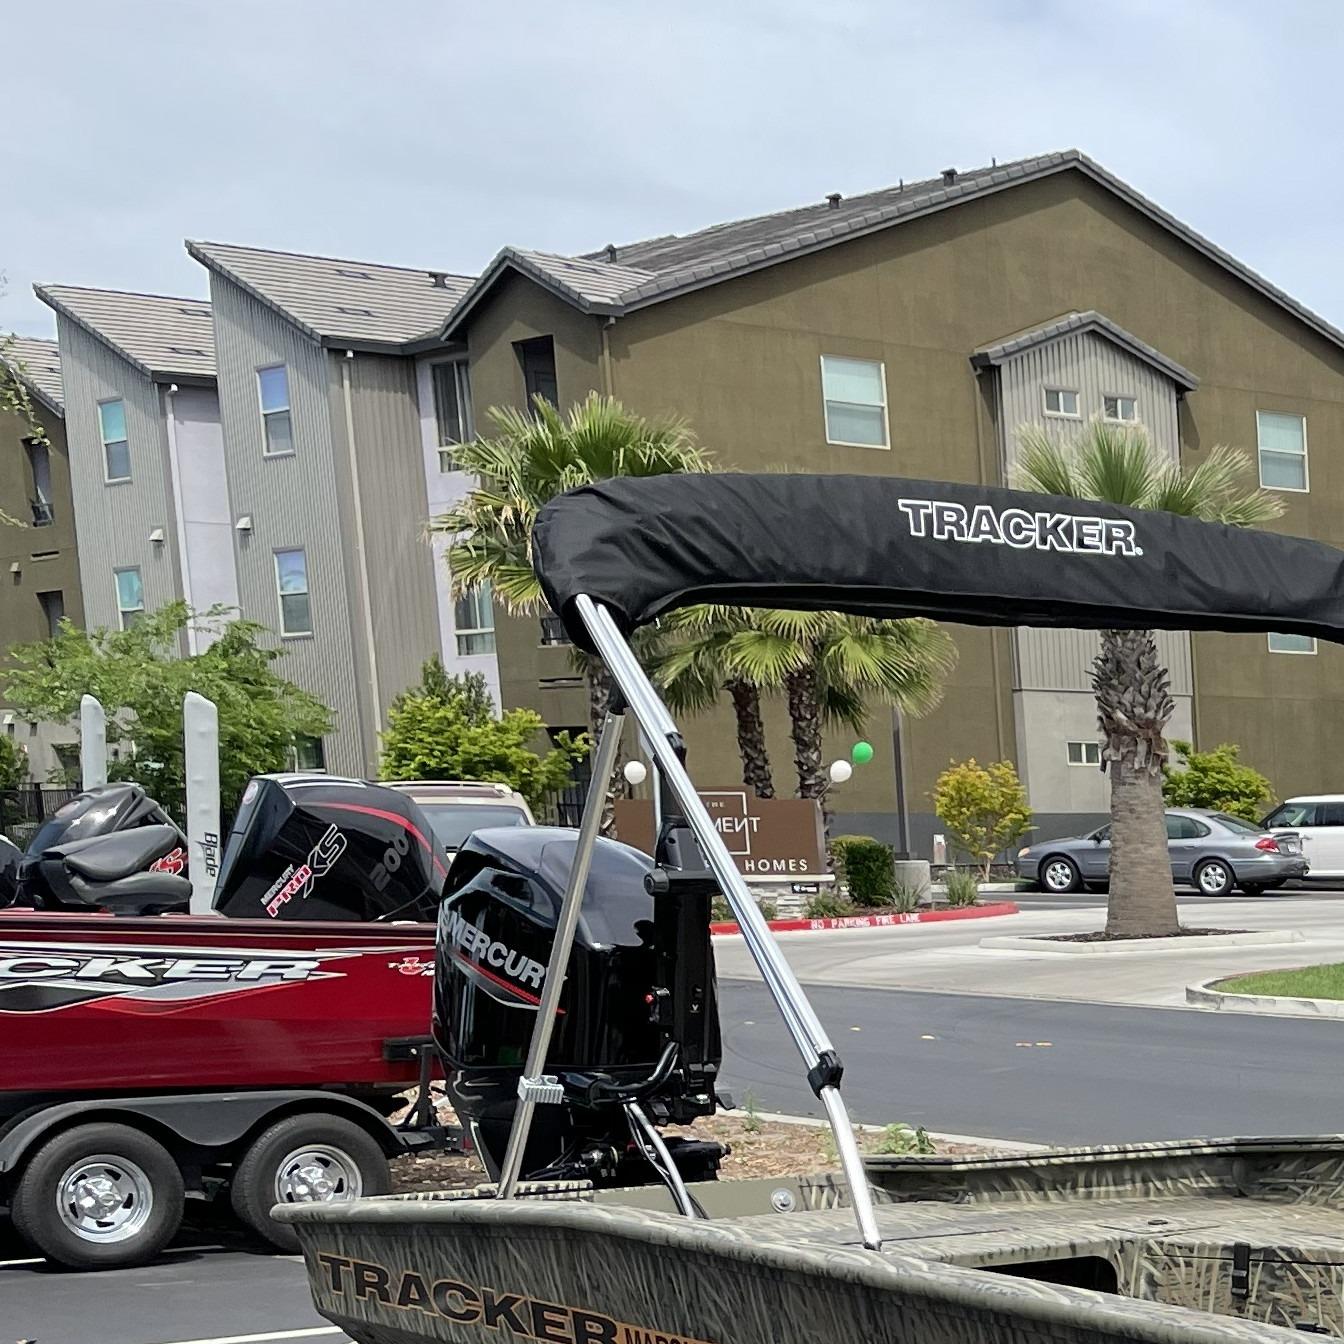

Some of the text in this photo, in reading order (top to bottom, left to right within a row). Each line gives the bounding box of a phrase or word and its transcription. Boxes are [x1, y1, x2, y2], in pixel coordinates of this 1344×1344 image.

[898, 499, 1136, 556] TRACKER
[714, 816, 761, 833] MENT
[196, 831, 219, 878] Blade
[744, 858, 808, 872] HOMES
[810, 912, 920, 930] NO PARKING FIRE LANE
[450, 911, 568, 989] MERCUR
